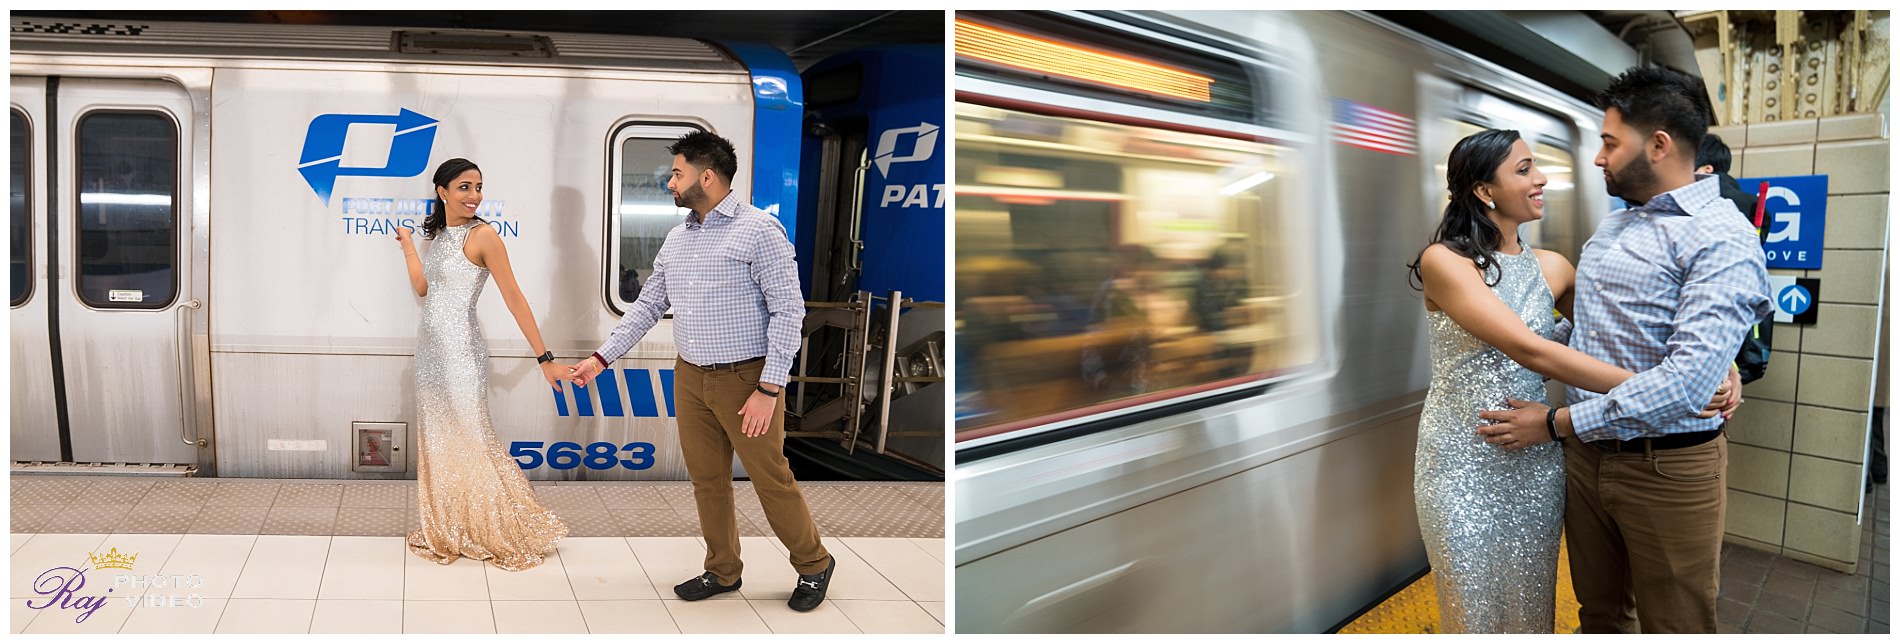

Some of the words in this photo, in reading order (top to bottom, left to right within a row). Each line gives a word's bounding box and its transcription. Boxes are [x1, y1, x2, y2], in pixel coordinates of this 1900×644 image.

[342, 197, 394, 214] PORT
[395, 198, 505, 216] AUTITY
[1767, 250, 1807, 261] OVE
[509, 441, 656, 471] 5683
